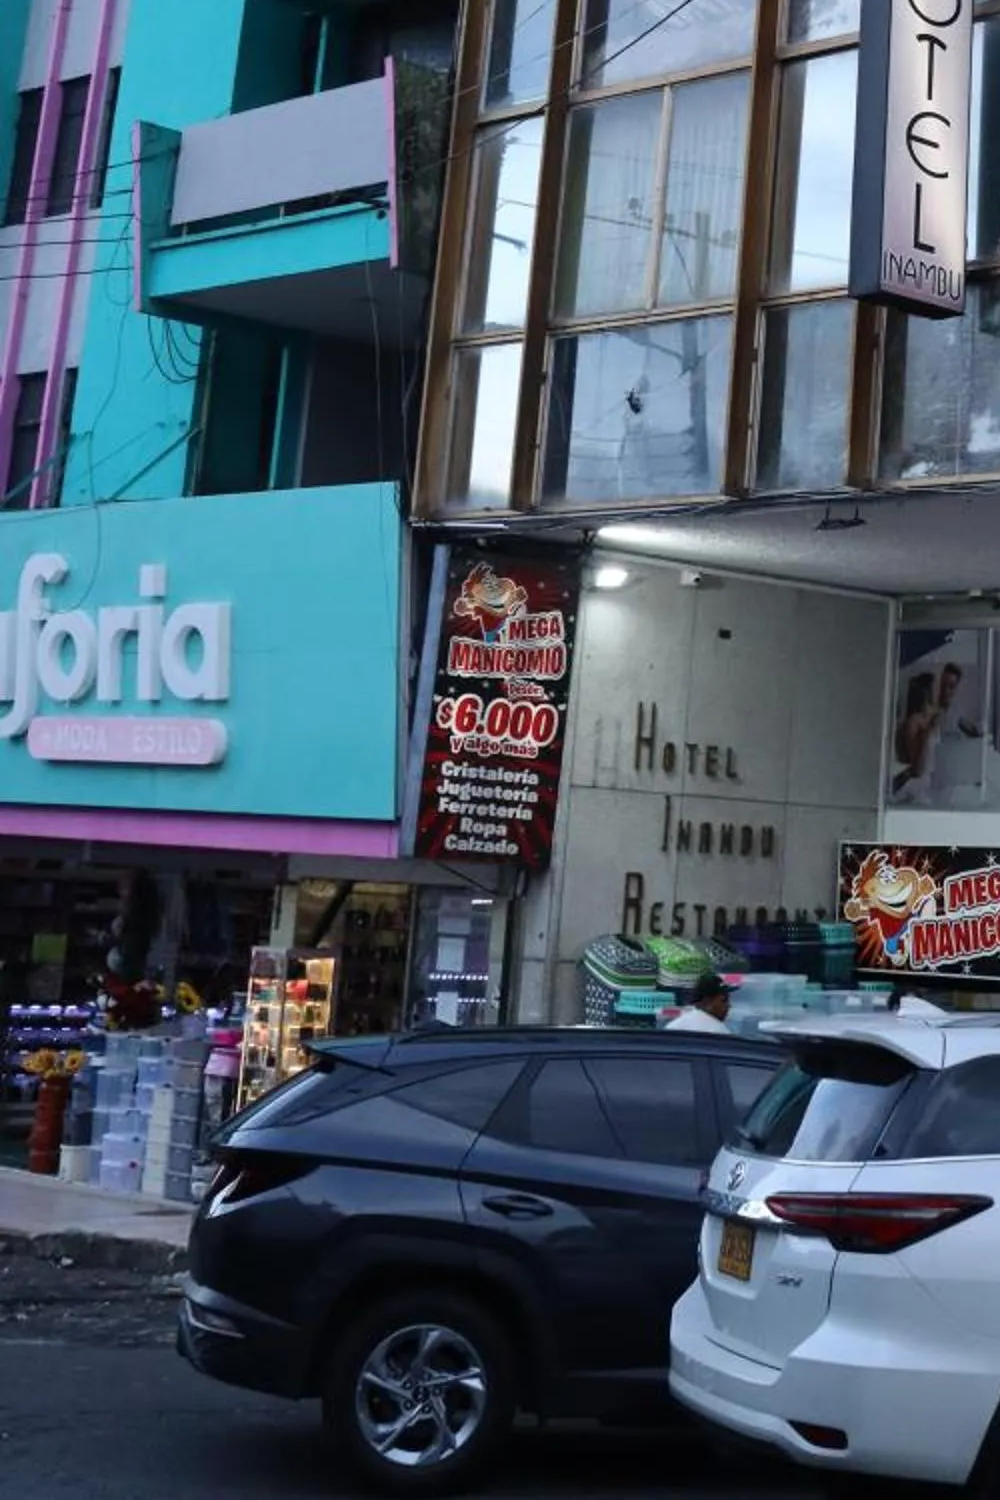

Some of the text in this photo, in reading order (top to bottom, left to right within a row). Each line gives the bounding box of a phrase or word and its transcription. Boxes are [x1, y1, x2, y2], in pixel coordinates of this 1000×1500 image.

[883, 254, 962, 301] INAMBU
[508, 614, 561, 640] MEGA
[450, 642, 564, 675] MANICOMIO
[437, 695, 557, 746] $6.000
[466, 736, 500, 755] algo
[634, 700, 739, 780] HOTEL
[441, 760, 539, 786] Cristalería
[437, 779, 539, 803] Juguetería
[438, 798, 533, 821] Ferretería
[460, 817, 507, 837] Ropa
[444, 835, 519, 856] Calzado
